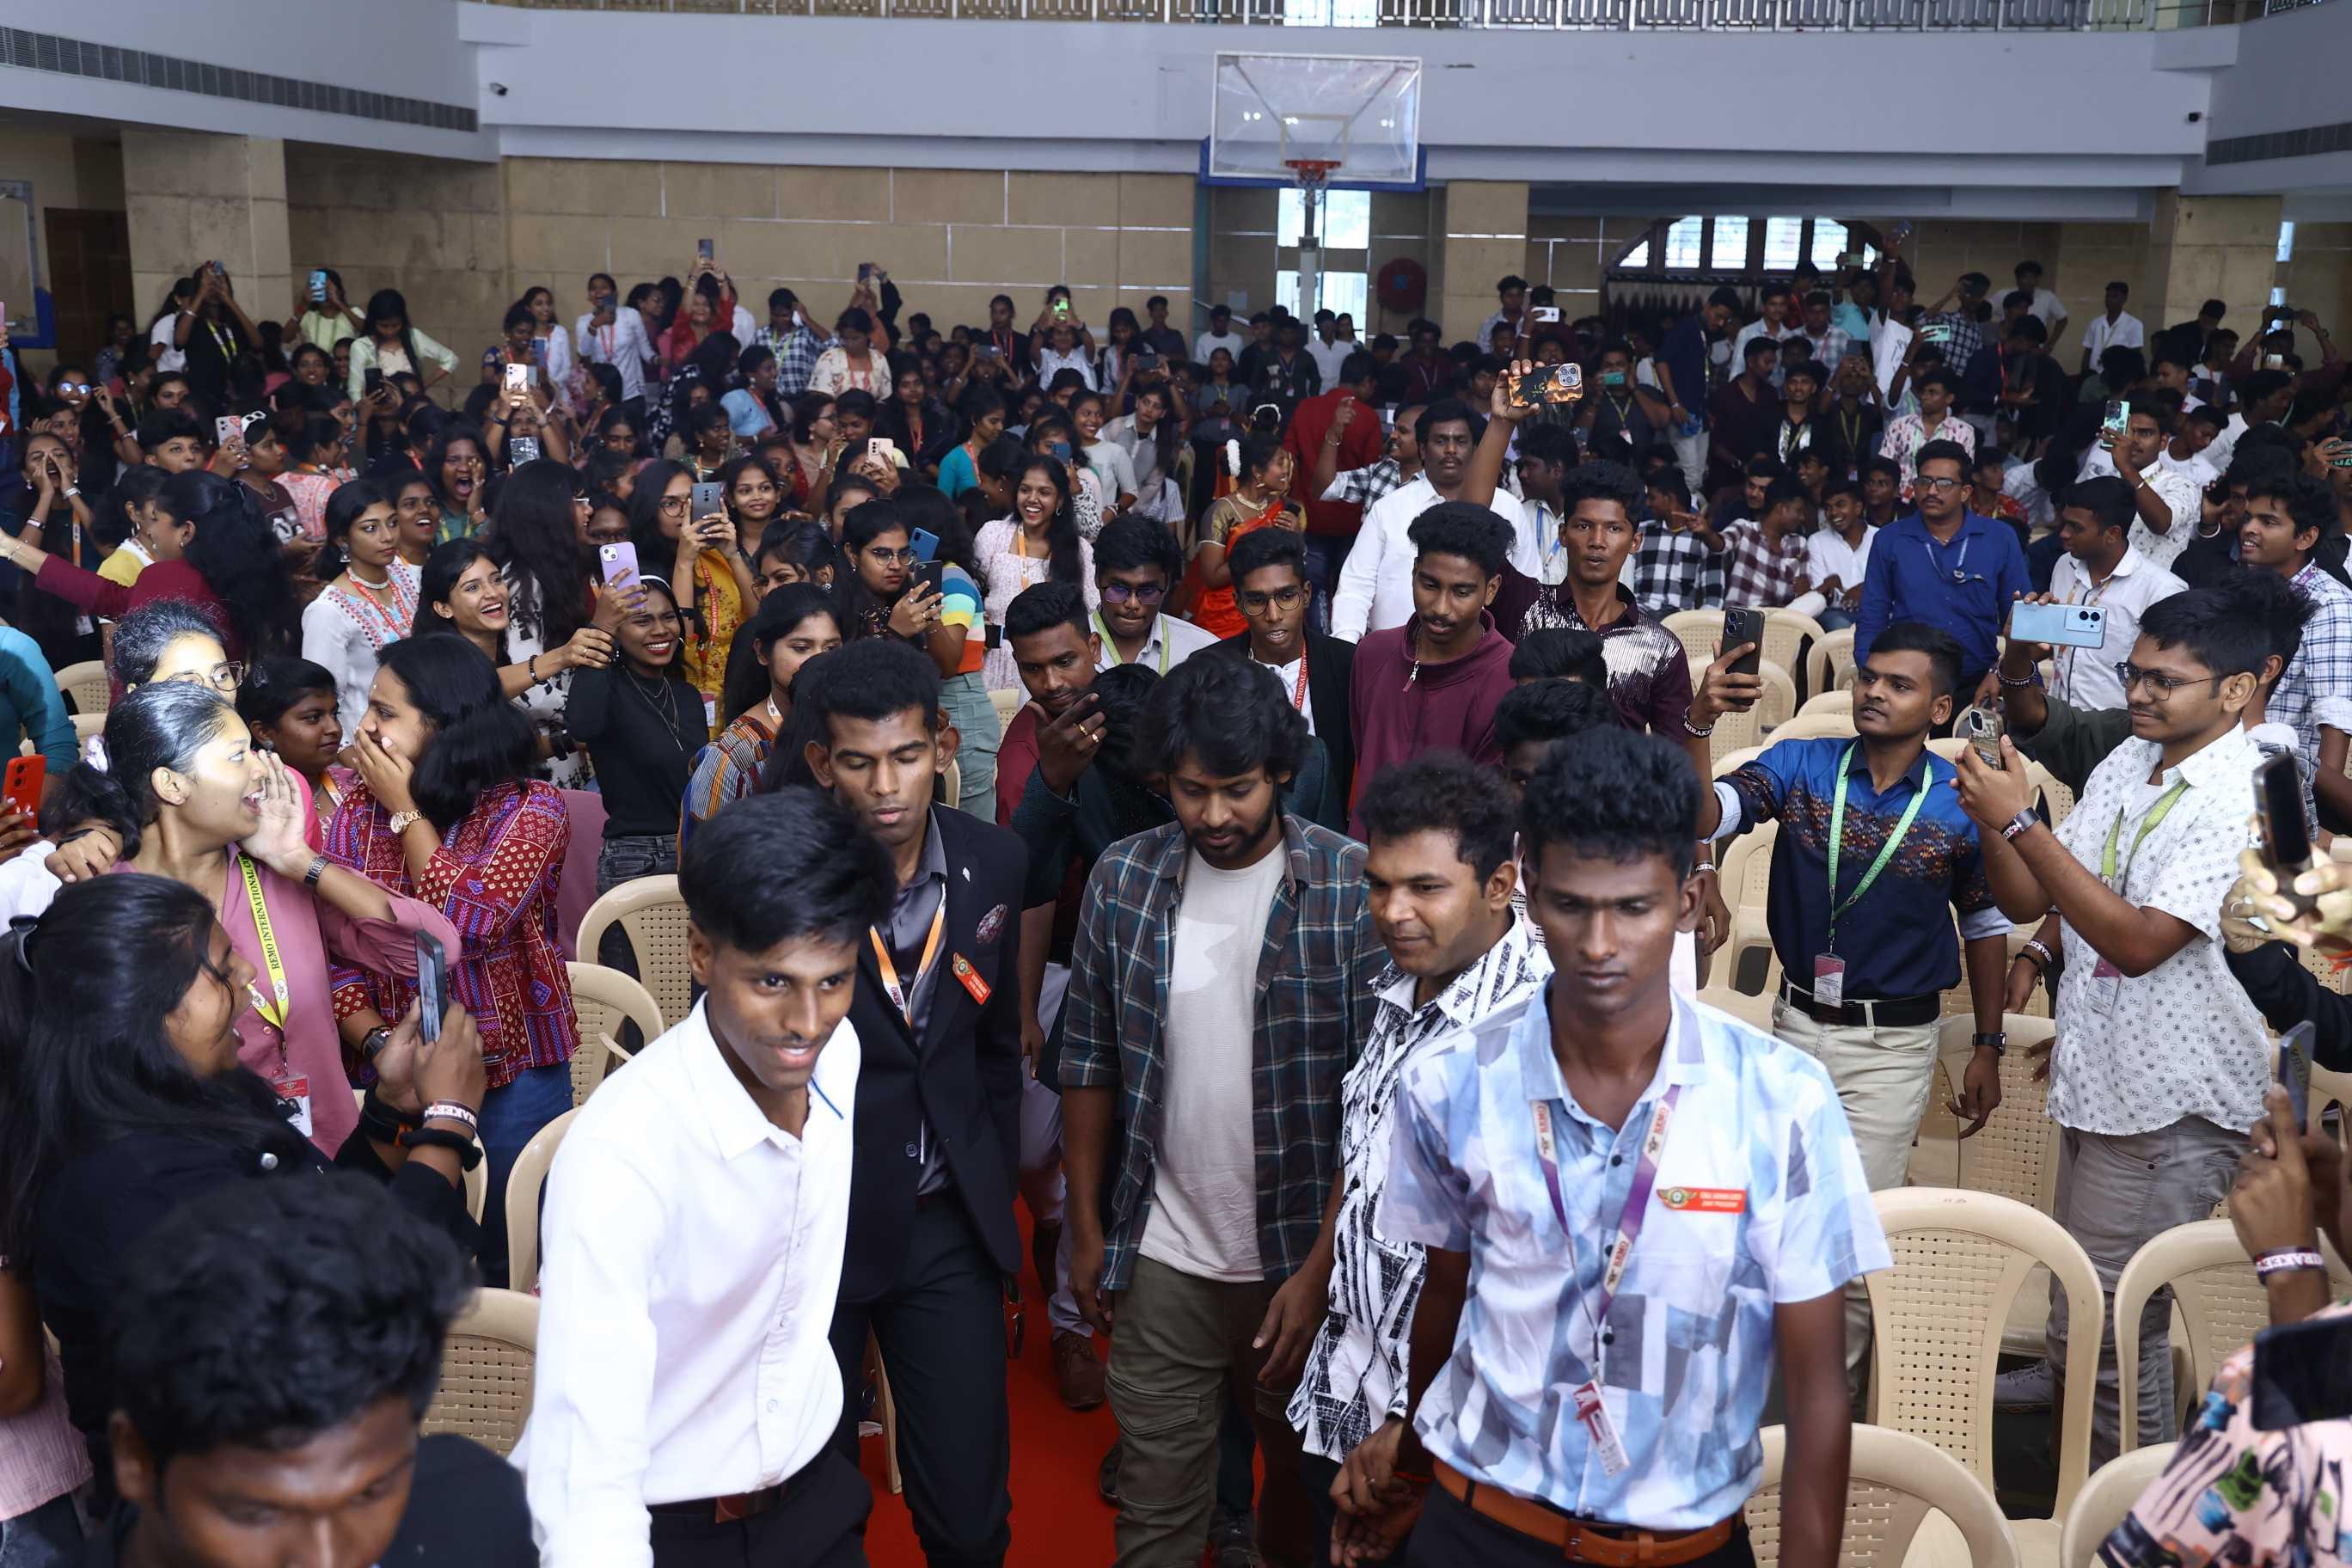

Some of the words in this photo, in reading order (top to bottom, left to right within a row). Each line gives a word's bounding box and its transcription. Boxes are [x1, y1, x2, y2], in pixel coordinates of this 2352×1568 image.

[246, 870, 273, 941] INTERNATIONAL
[266, 943, 280, 970] REMO
[1537, 1106, 1548, 1133] REMO
[1654, 1107, 1669, 1134] REMO
[1613, 1240, 1628, 1266] REMO
